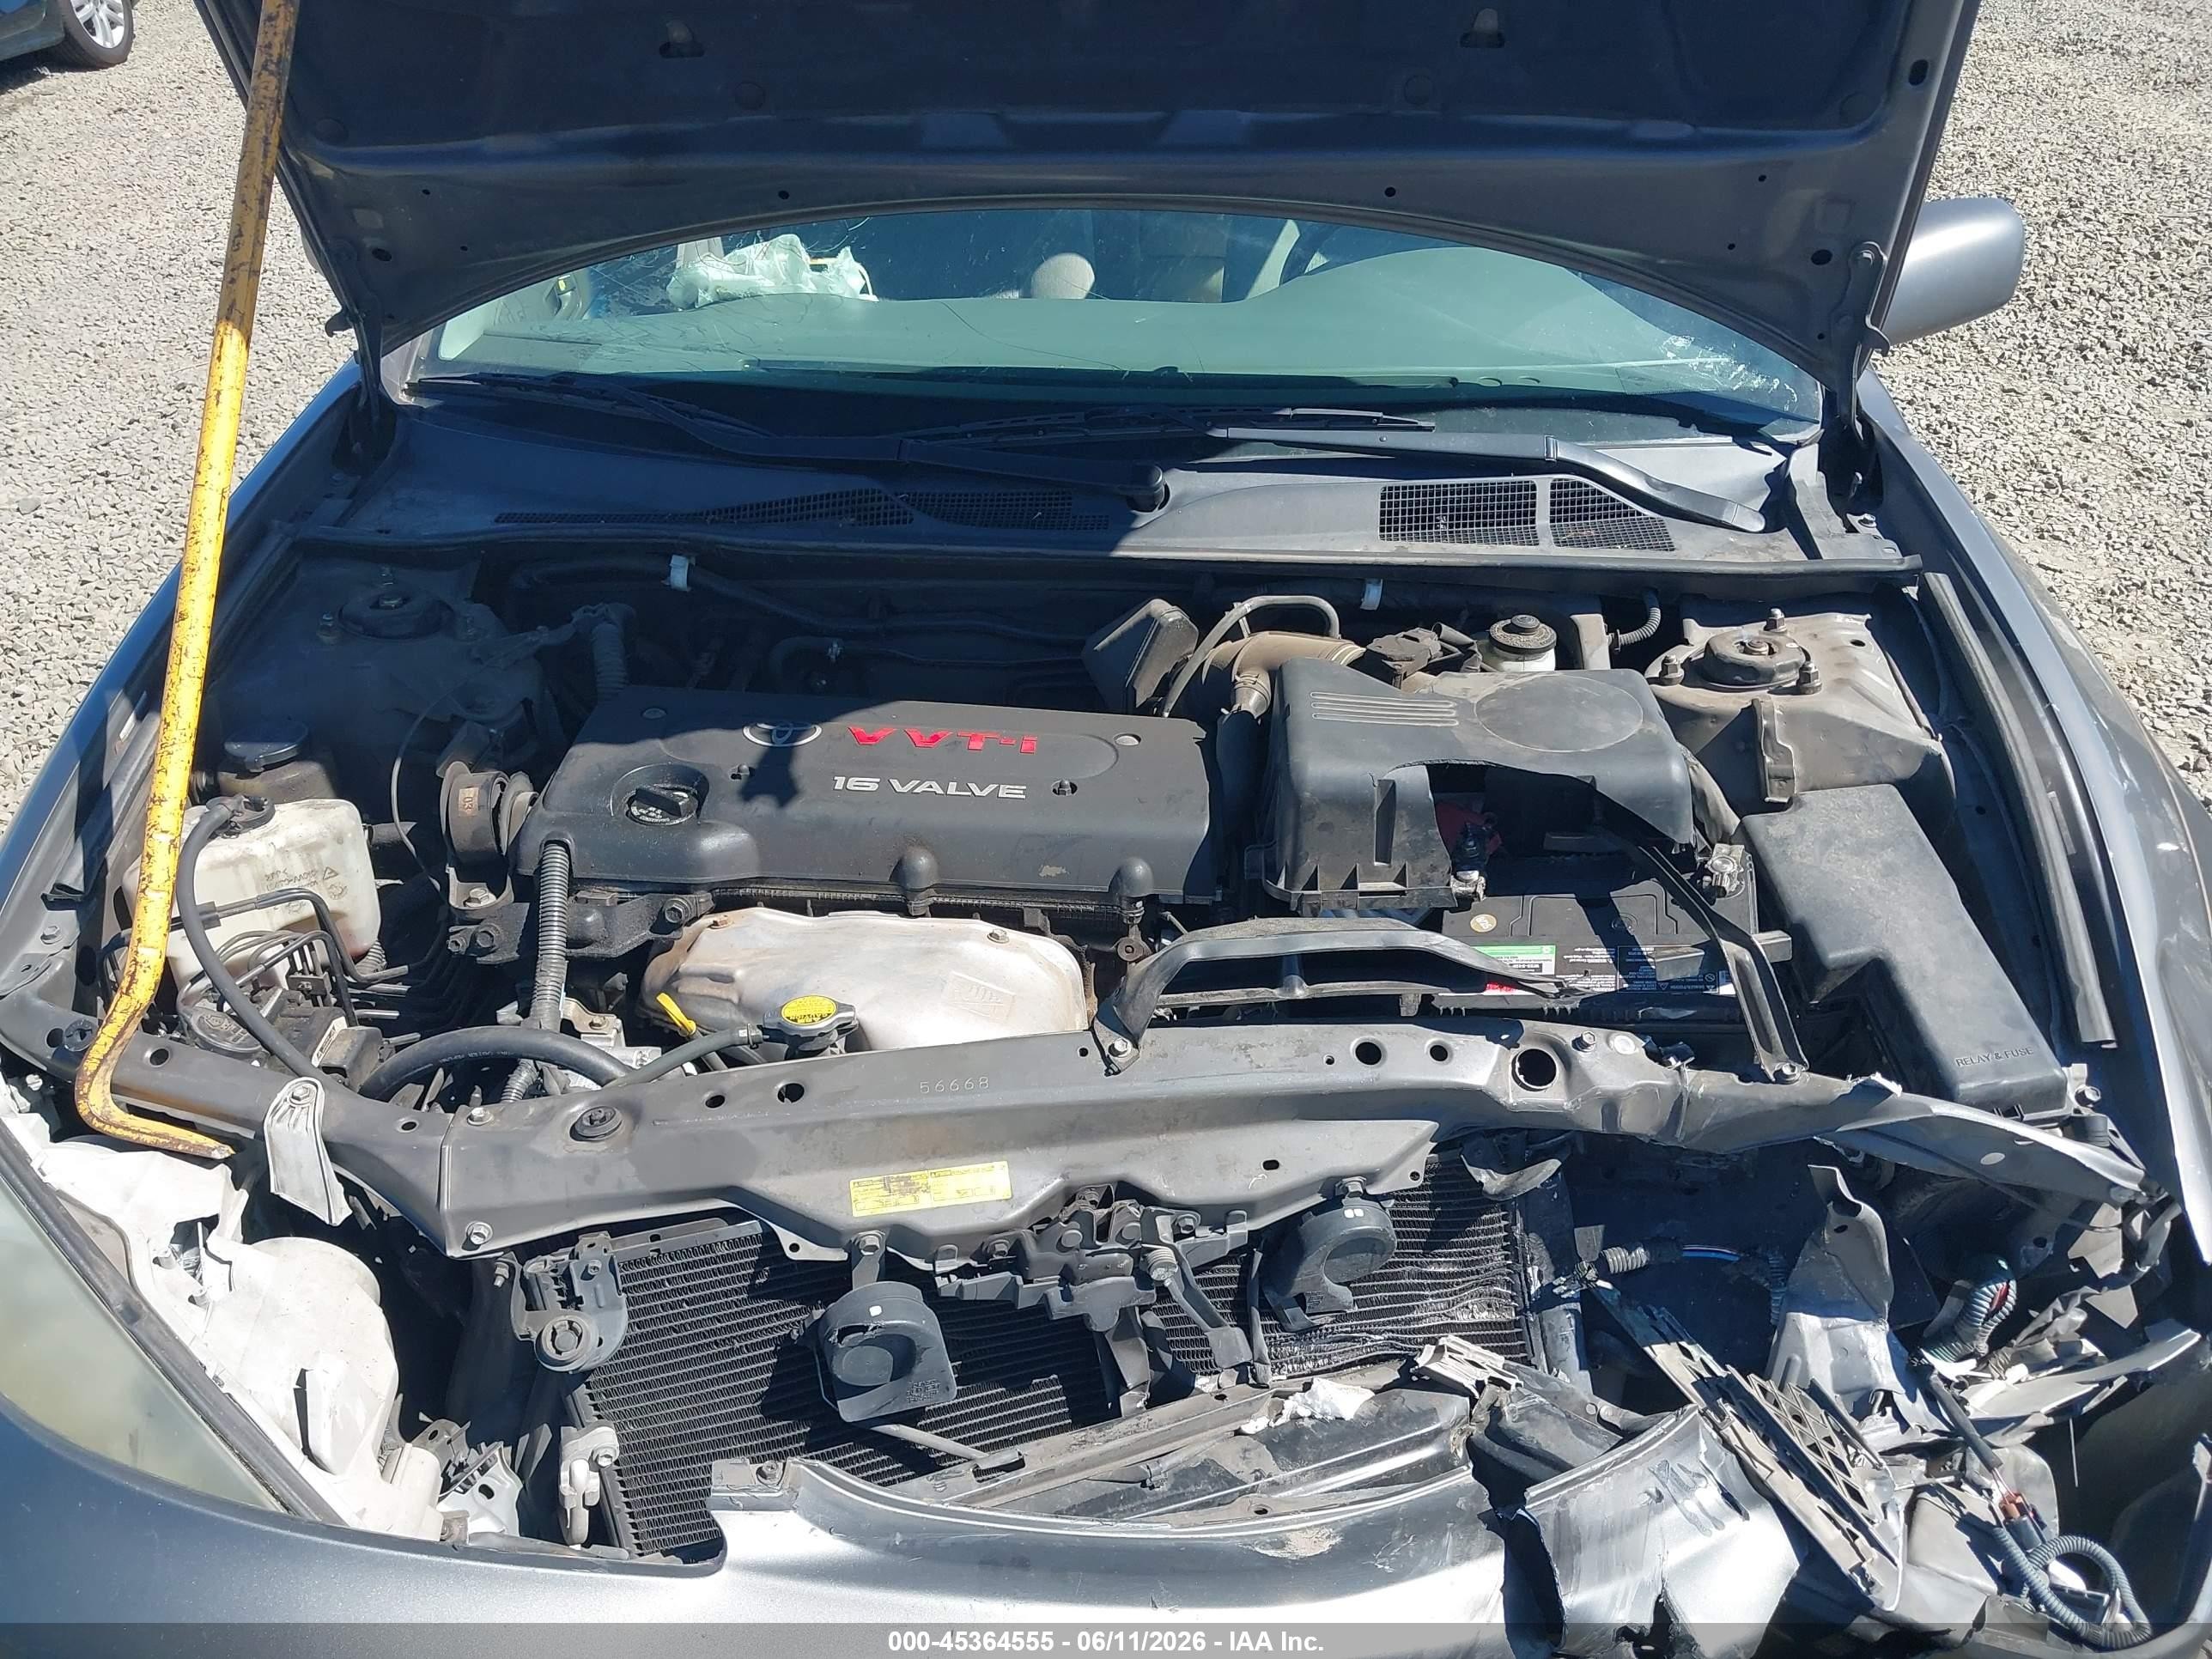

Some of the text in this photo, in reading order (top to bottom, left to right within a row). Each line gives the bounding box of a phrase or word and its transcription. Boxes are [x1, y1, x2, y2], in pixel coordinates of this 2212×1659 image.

[833, 776, 1027, 799] 16 VALVE
[1955, 1046, 2034, 1067] RELAY & FUSE
[920, 1076, 989, 1095] 56668
